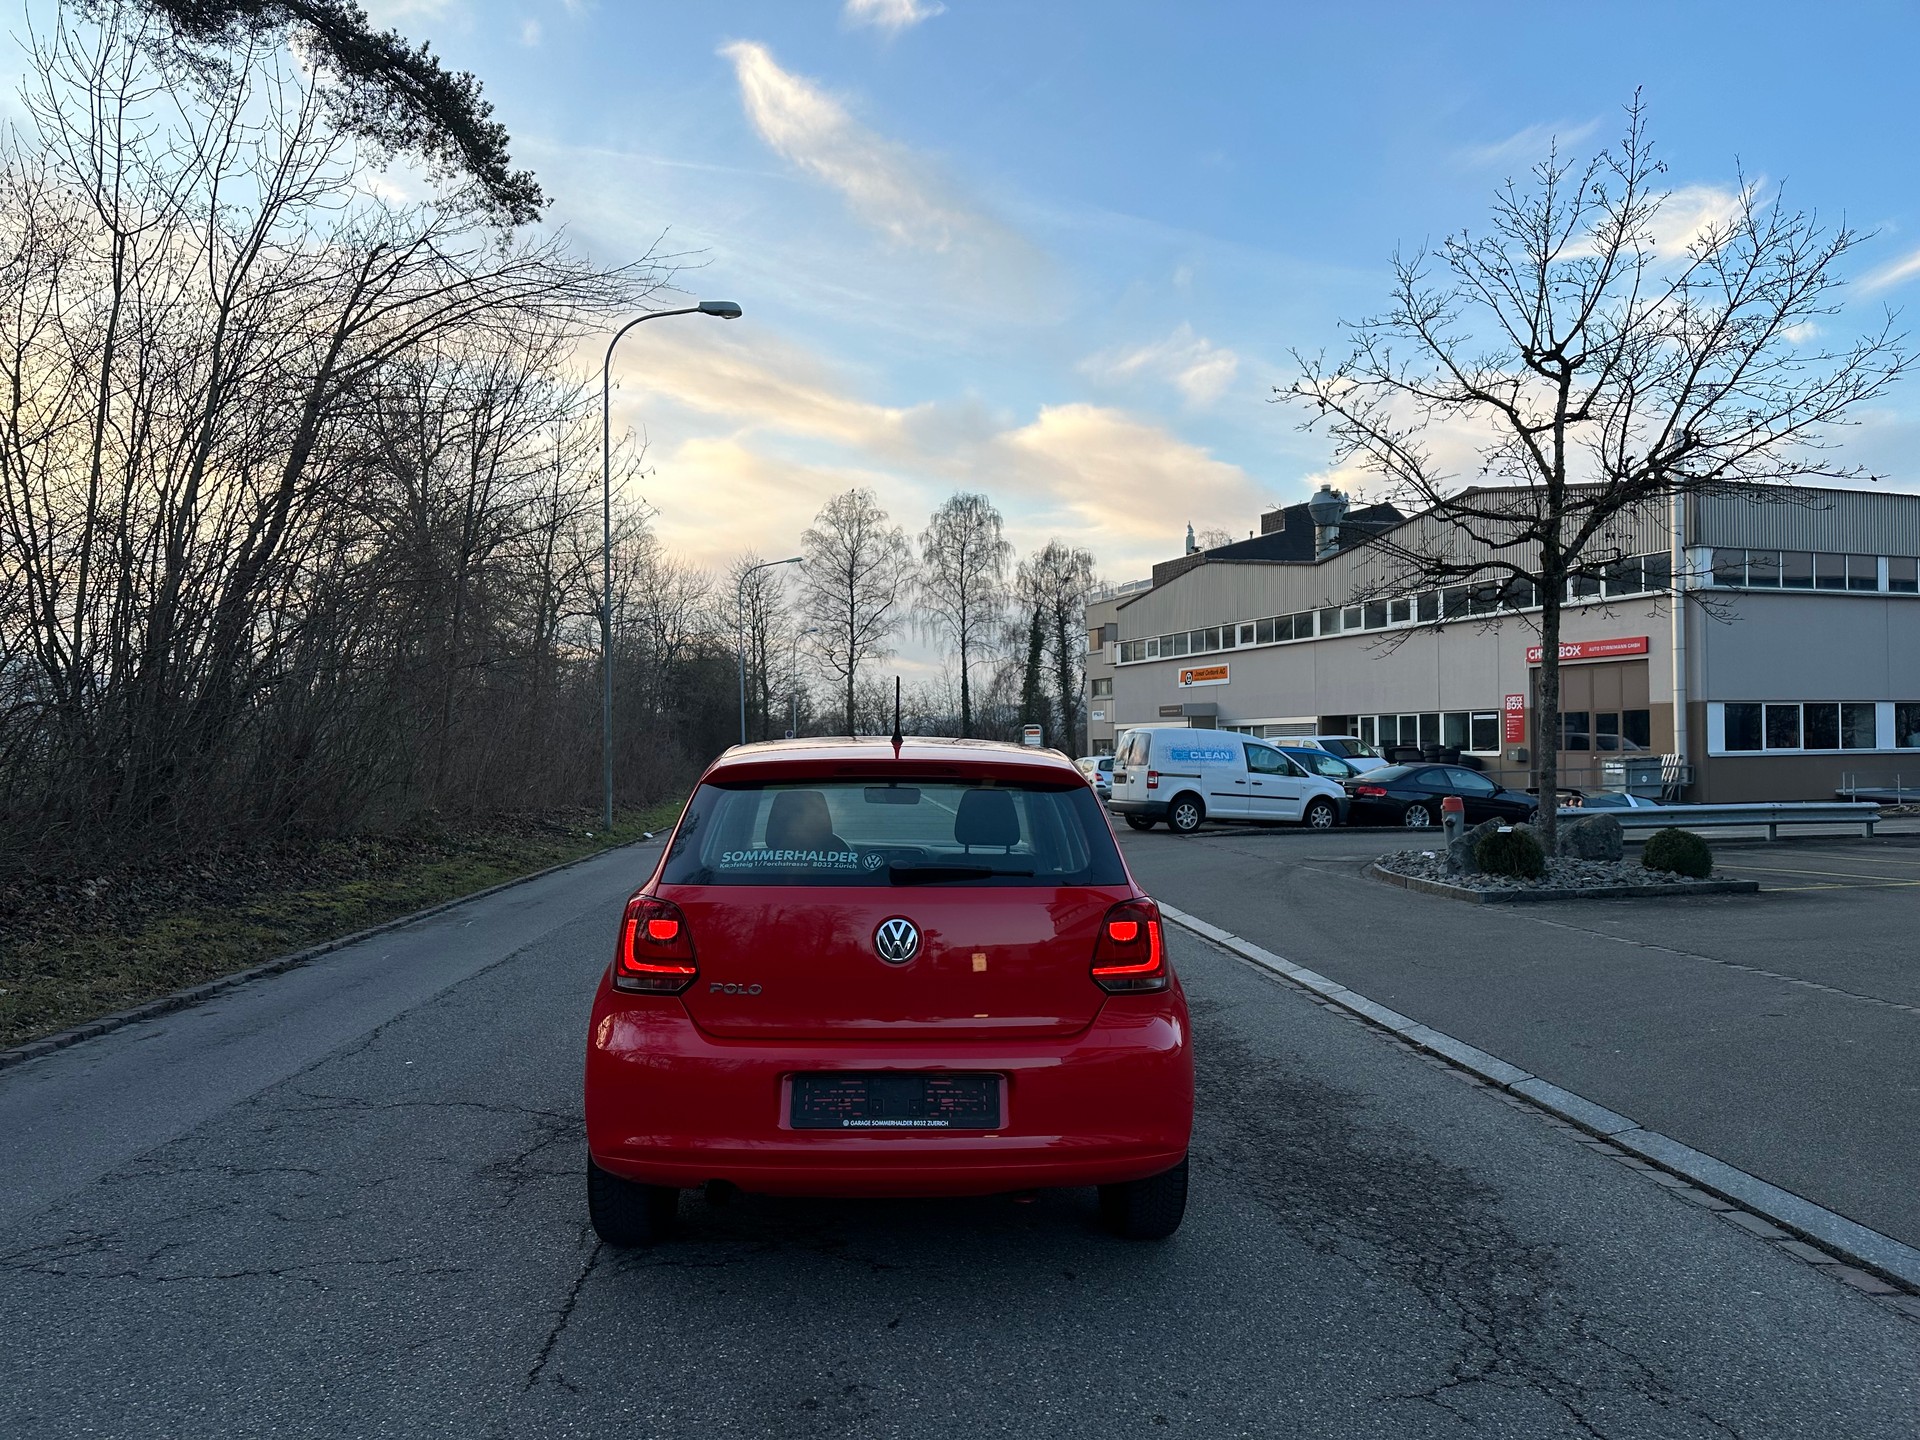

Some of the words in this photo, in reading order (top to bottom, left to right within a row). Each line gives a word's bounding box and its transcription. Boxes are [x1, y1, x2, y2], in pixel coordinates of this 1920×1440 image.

[1506, 702, 1523, 710] BOX
[721, 850, 859, 863] SOMMERHALDER
[709, 982, 762, 995] POLO
